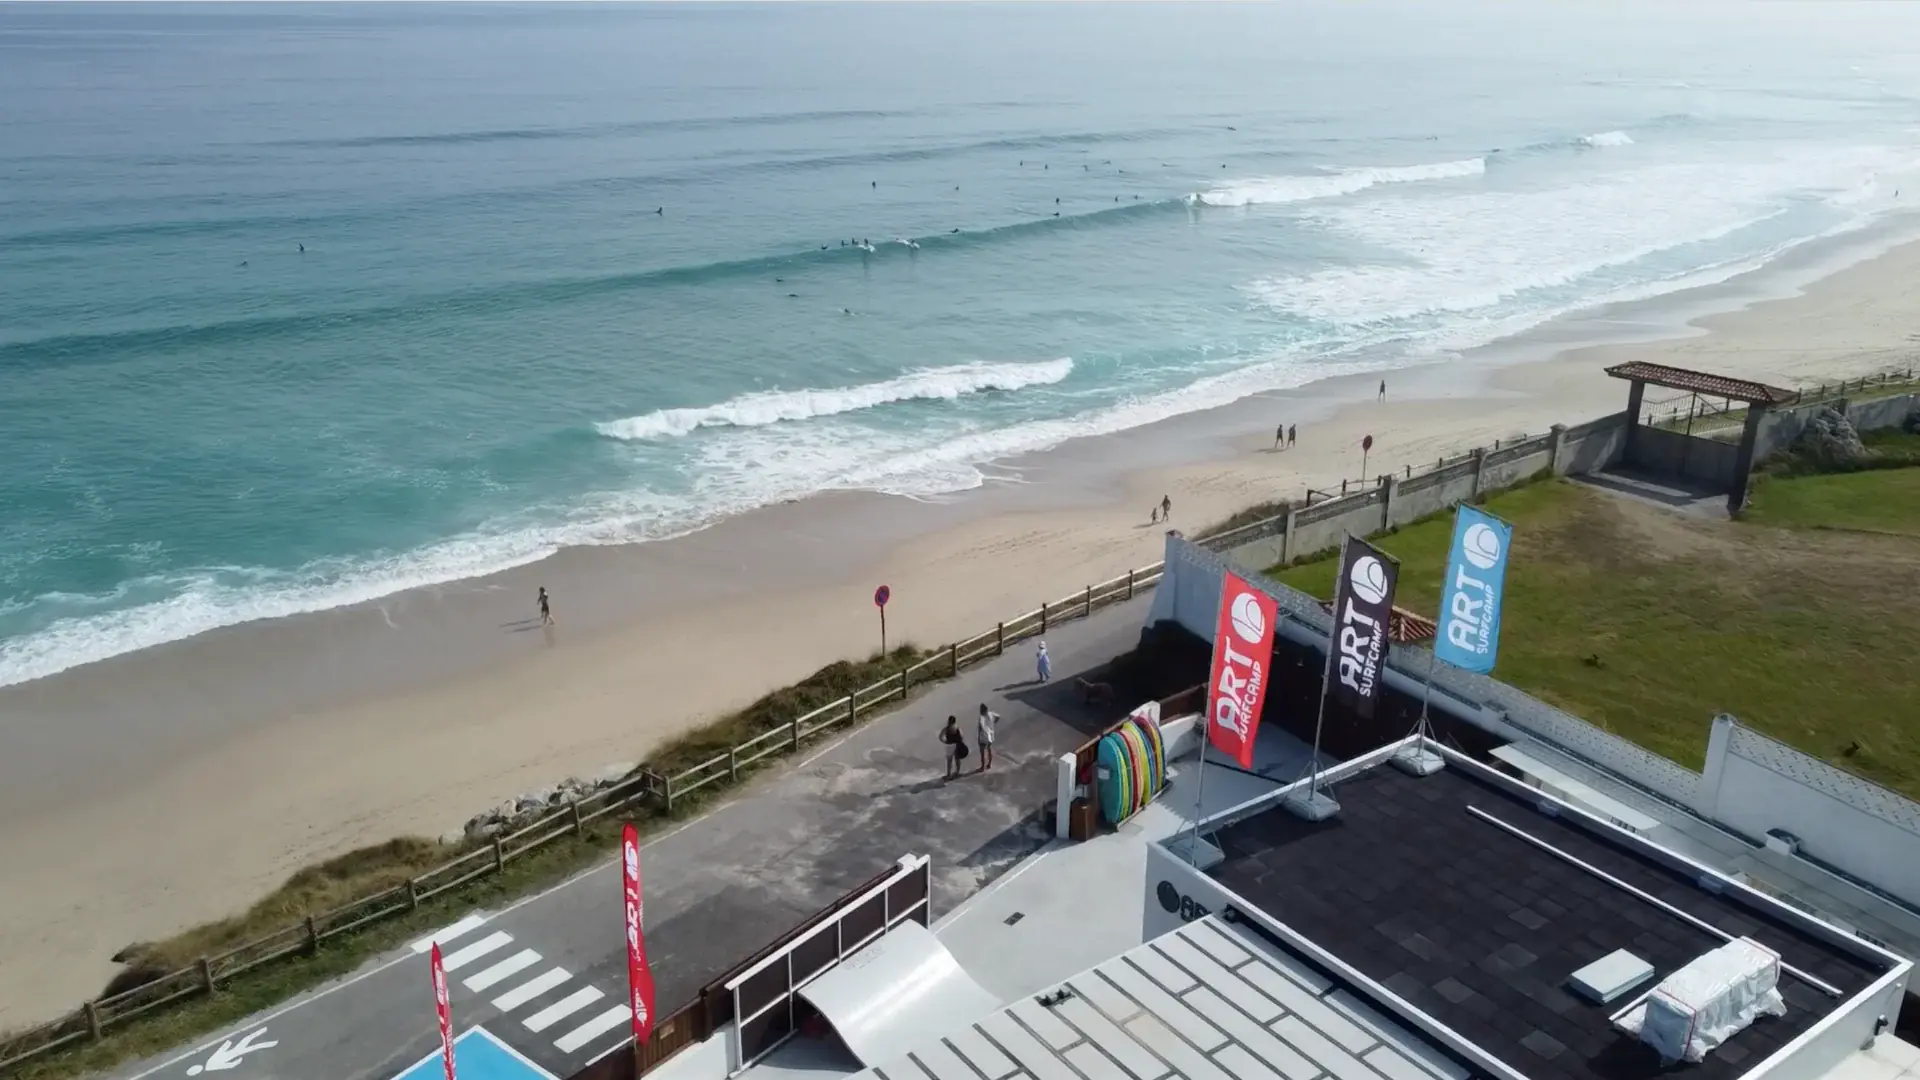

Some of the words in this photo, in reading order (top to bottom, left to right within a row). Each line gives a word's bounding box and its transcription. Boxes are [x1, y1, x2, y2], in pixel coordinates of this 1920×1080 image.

[1340, 596, 1374, 692] ART
[1448, 564, 1484, 652] ART
[1476, 584, 1495, 654] SURFCAMP
[1216, 636, 1252, 737] ART
[1240, 660, 1262, 744] SURFCAMP
[1360, 620, 1383, 699] SURFCAMP
